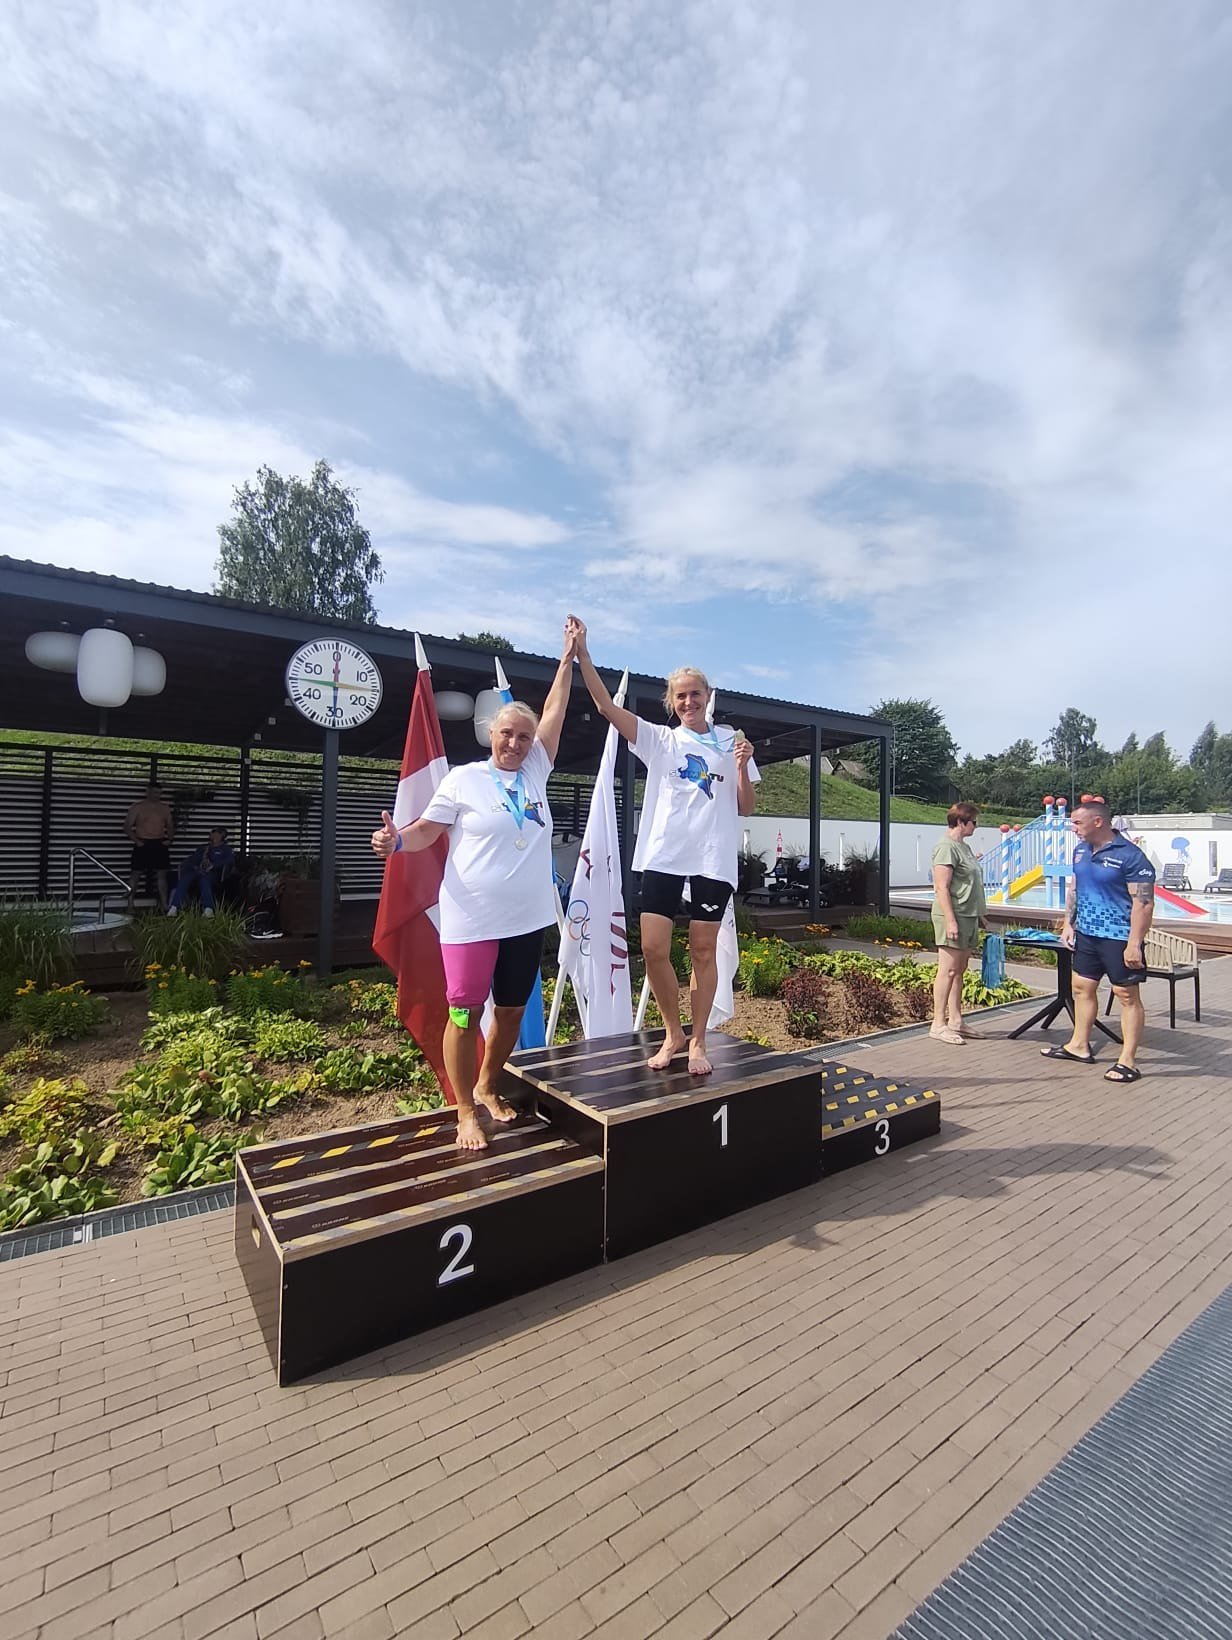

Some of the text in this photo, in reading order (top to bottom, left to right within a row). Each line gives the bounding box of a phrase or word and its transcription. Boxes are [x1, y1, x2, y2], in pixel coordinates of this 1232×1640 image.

[332, 651, 341, 662] 0
[304, 662, 323, 675] 50
[356, 670, 368, 683] 10
[303, 688, 321, 700] 40
[349, 694, 367, 707] 20
[326, 706, 343, 718] 30
[712, 1104, 728, 1146] 1
[874, 1119, 890, 1155] 3
[438, 1224, 475, 1286] 2
